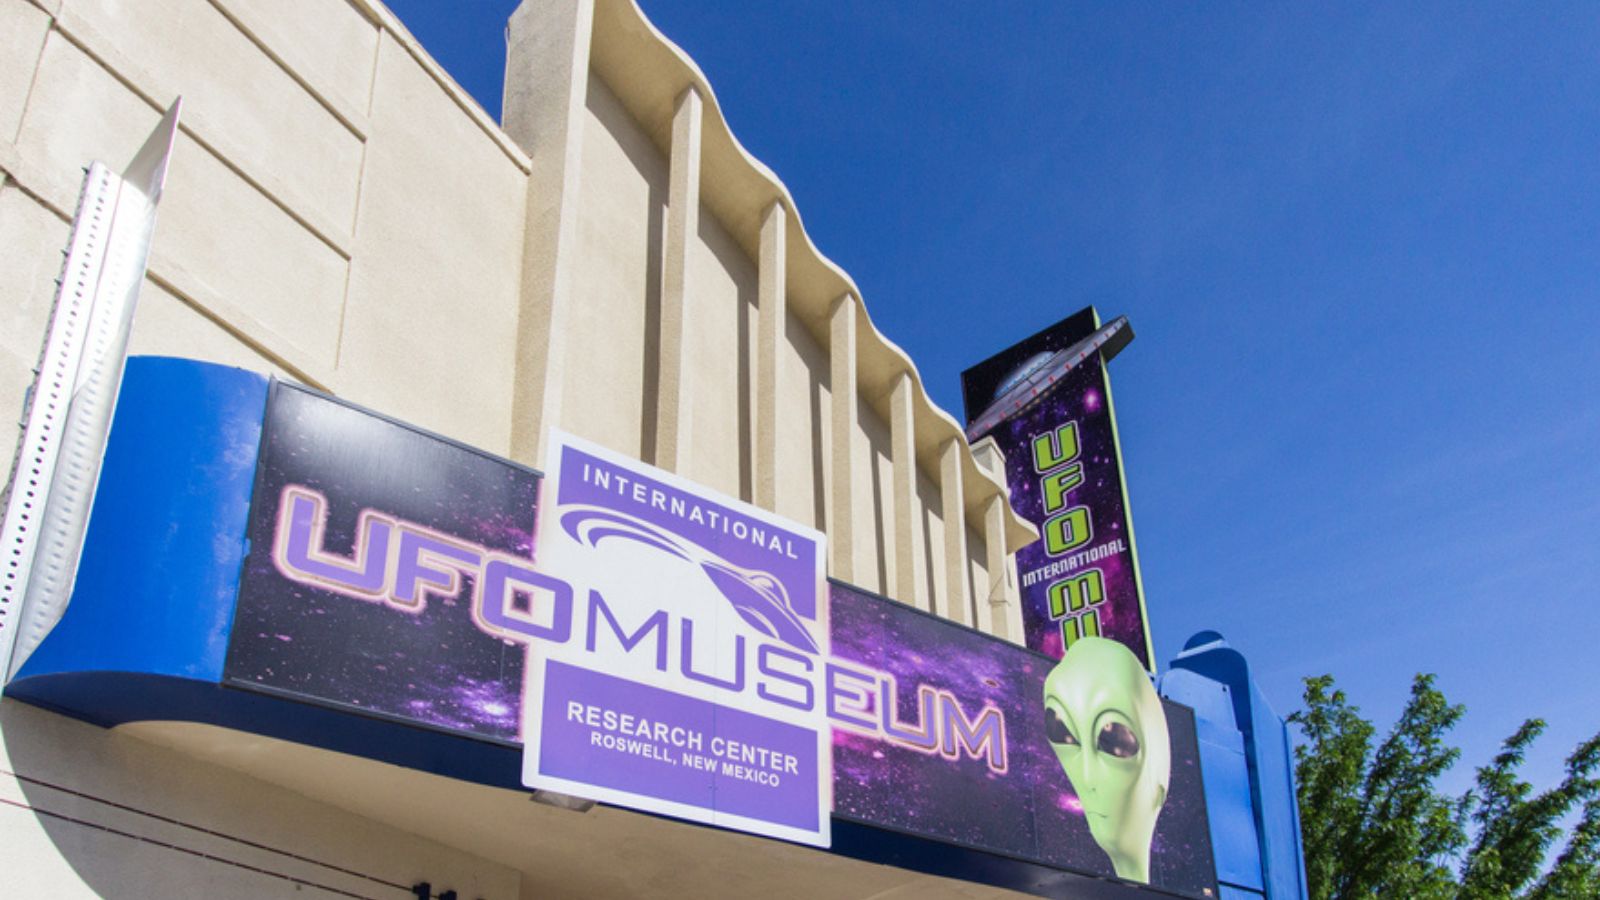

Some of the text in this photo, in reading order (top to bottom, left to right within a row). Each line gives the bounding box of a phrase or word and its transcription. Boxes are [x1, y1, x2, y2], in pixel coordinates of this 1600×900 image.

[583, 464, 798, 559] INTERNATIONAL
[1032, 420, 1092, 557] UFO
[1023, 539, 1126, 587] INTERNATIONAL
[567, 700, 799, 775] RESEARCH CENTER
[590, 731, 780, 787] ROSWELL, NEW MEXICO
